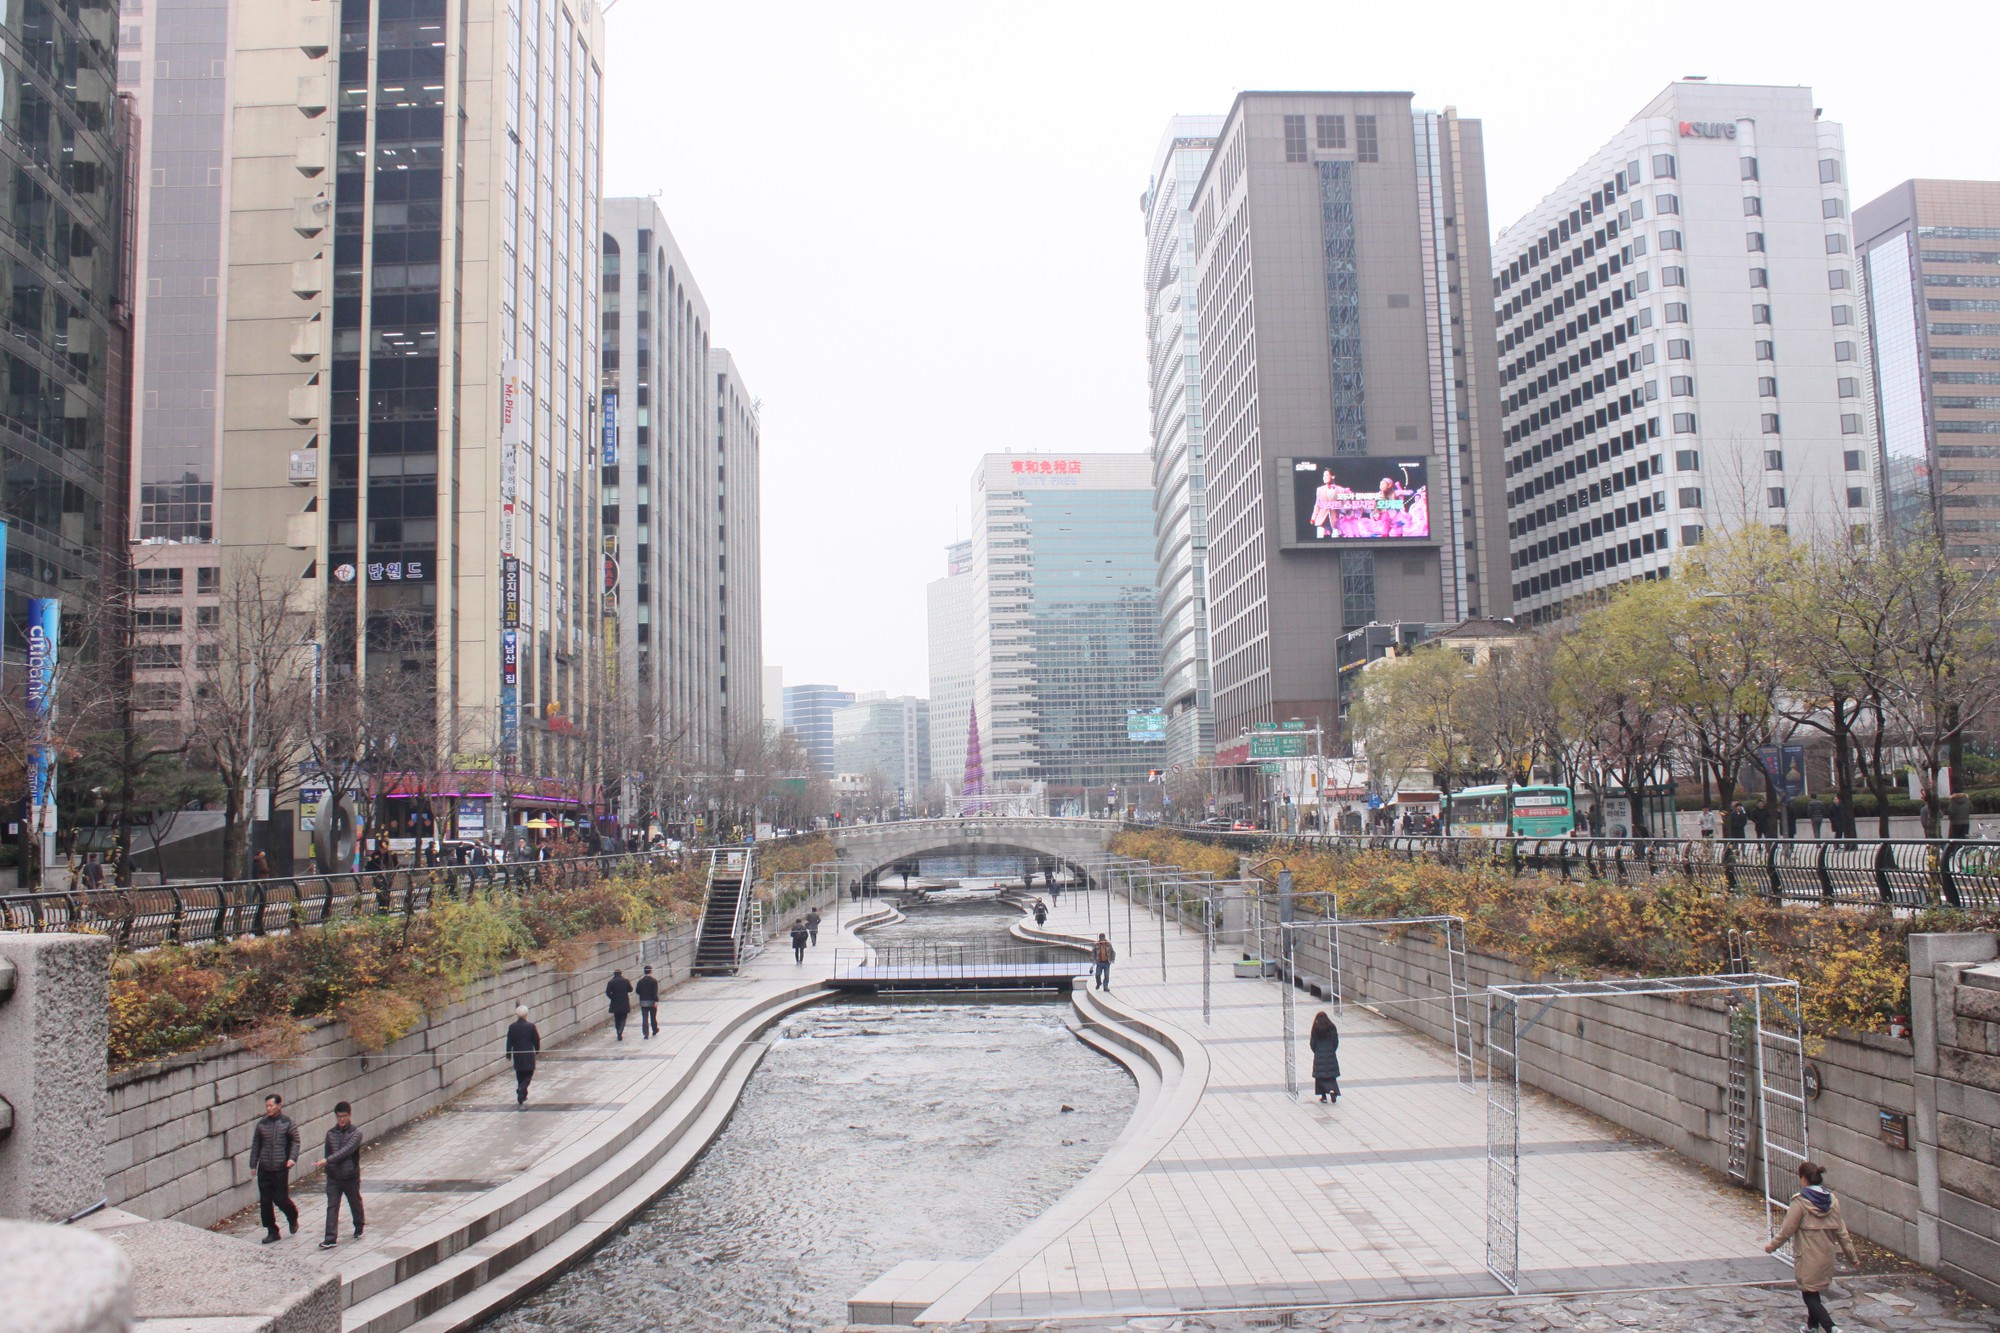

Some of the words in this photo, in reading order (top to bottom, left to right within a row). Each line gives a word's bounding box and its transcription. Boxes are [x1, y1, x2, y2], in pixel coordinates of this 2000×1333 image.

[290, 461, 315, 475] 내과
[1051, 476, 1077, 486] FREE
[368, 562, 423, 580] 단월드
[505, 572, 517, 621] 오지연치과
[28, 625, 46, 702] citibank
